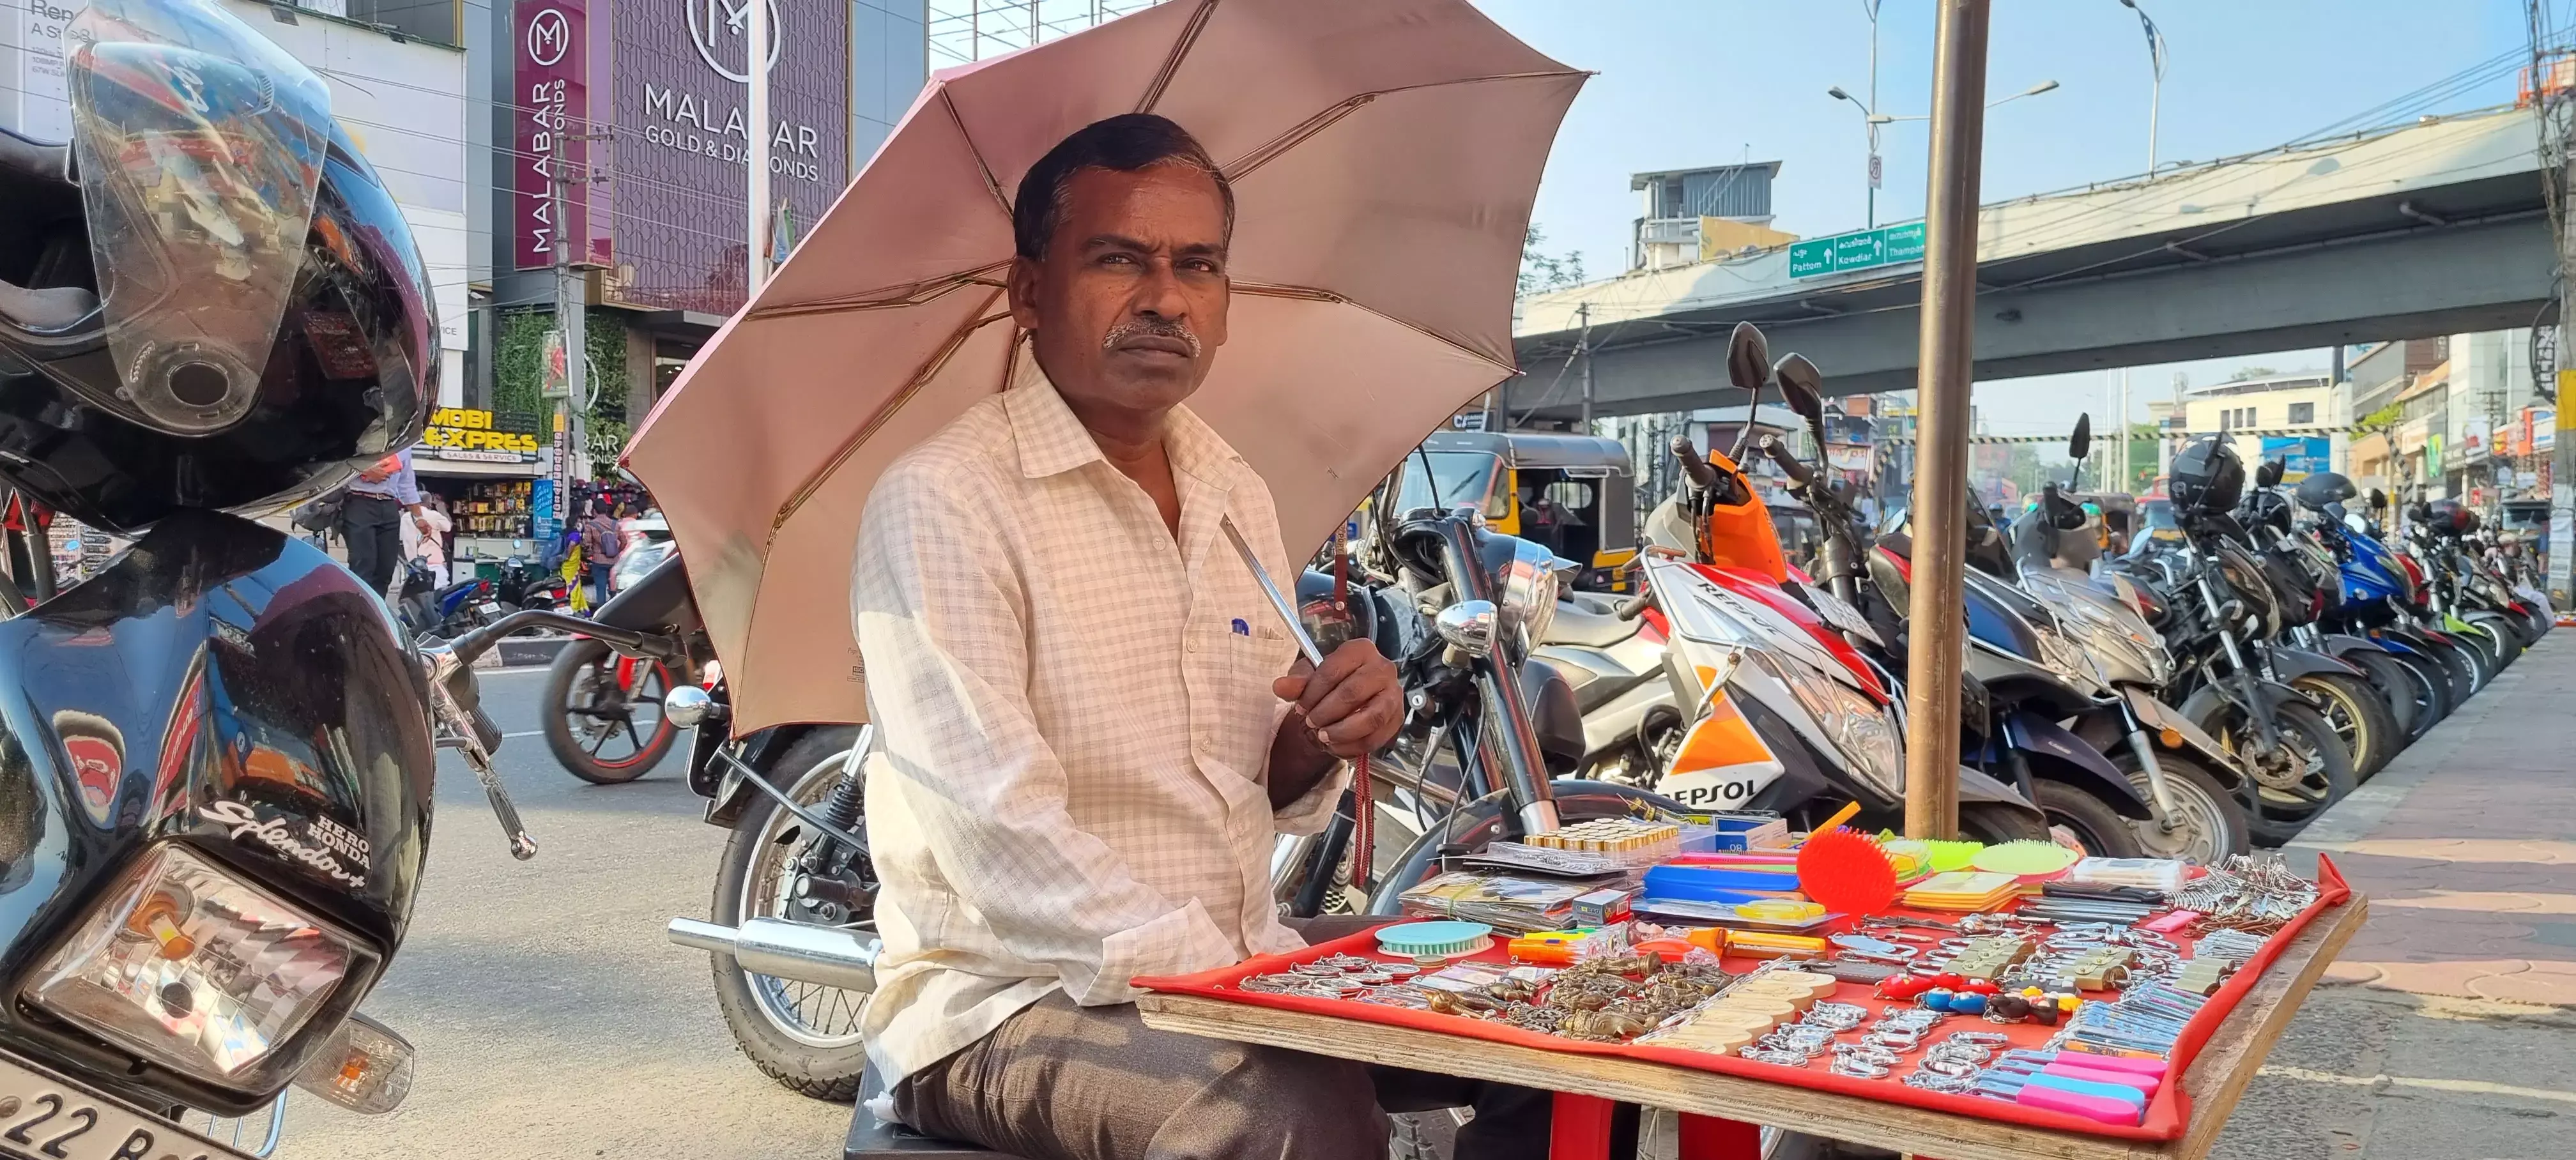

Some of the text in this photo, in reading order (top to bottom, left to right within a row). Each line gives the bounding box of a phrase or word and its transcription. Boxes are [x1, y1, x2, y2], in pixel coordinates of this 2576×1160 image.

[31, 22, 43, 35] A
[645, 83, 818, 158] MALAAR
[533, 81, 551, 252] MALABAR
[645, 125, 818, 181] GOLD & DIAONDS
[1793, 262, 1822, 272] Pattom
[1838, 252, 1872, 265] Kowdiar
[431, 408, 493, 429] MOBI
[484, 453, 517, 461] SERVICE
[1697, 582, 1779, 636] REPSOL
[198, 800, 365, 888] Splendor+
[307, 822, 371, 870] HONDA
[318, 814, 369, 853] HERO
[4, 1093, 98, 1159] 22
